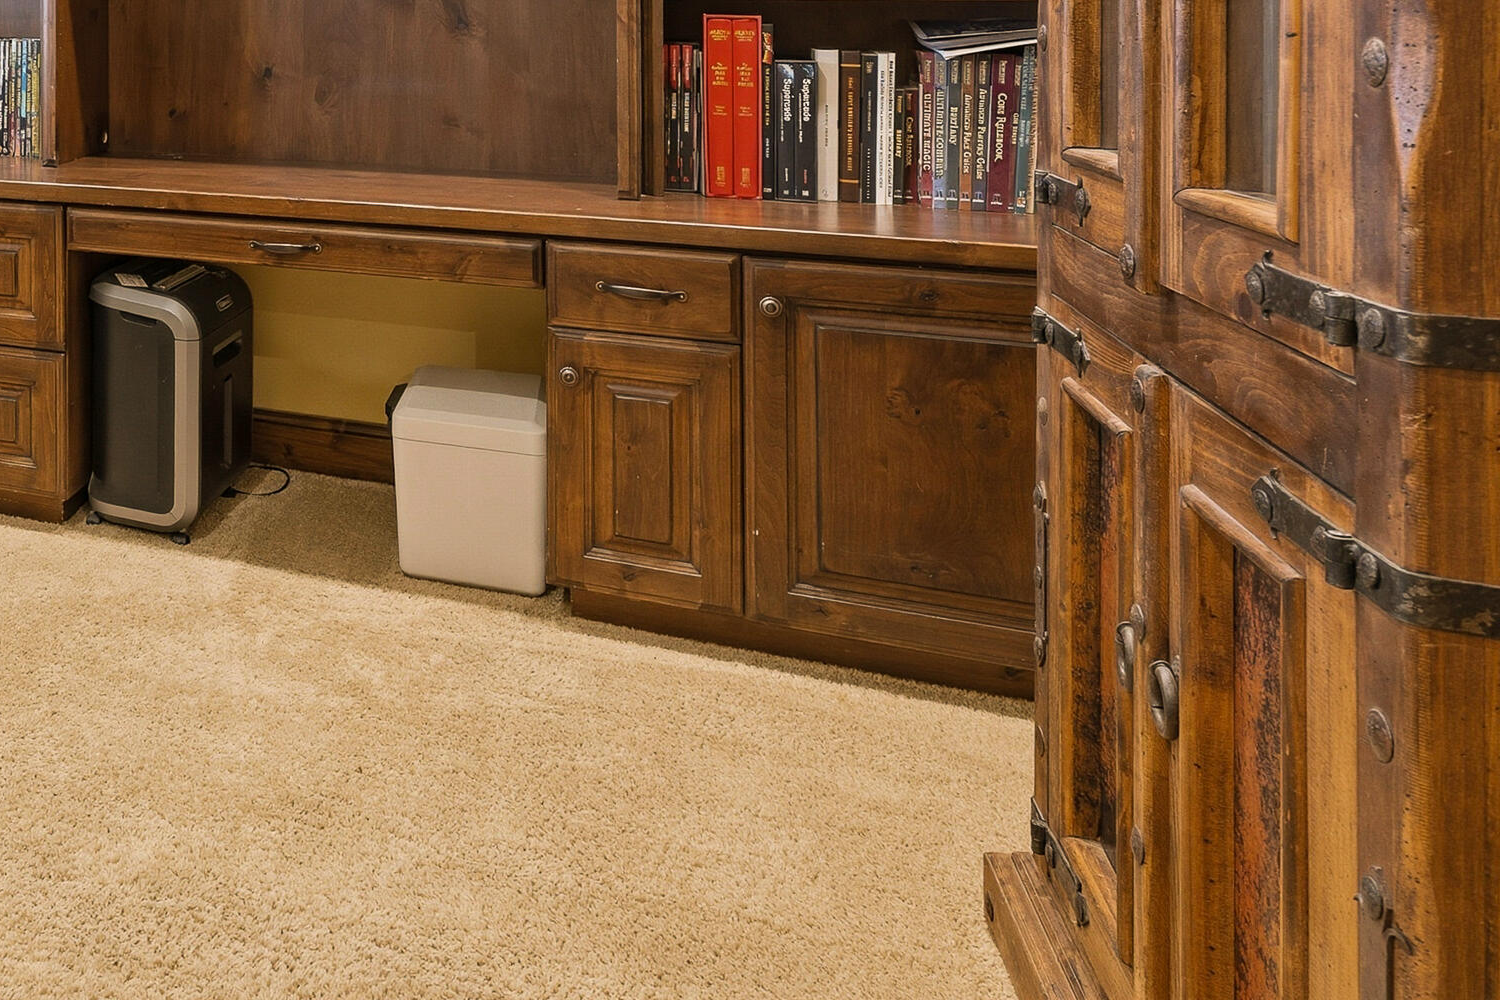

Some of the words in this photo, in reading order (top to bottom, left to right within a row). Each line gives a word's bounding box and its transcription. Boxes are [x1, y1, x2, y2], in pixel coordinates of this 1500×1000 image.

[923, 93, 932, 137] ULTIMATE
[997, 92, 1007, 115] CORE
[923, 140, 932, 171] MAGIC
